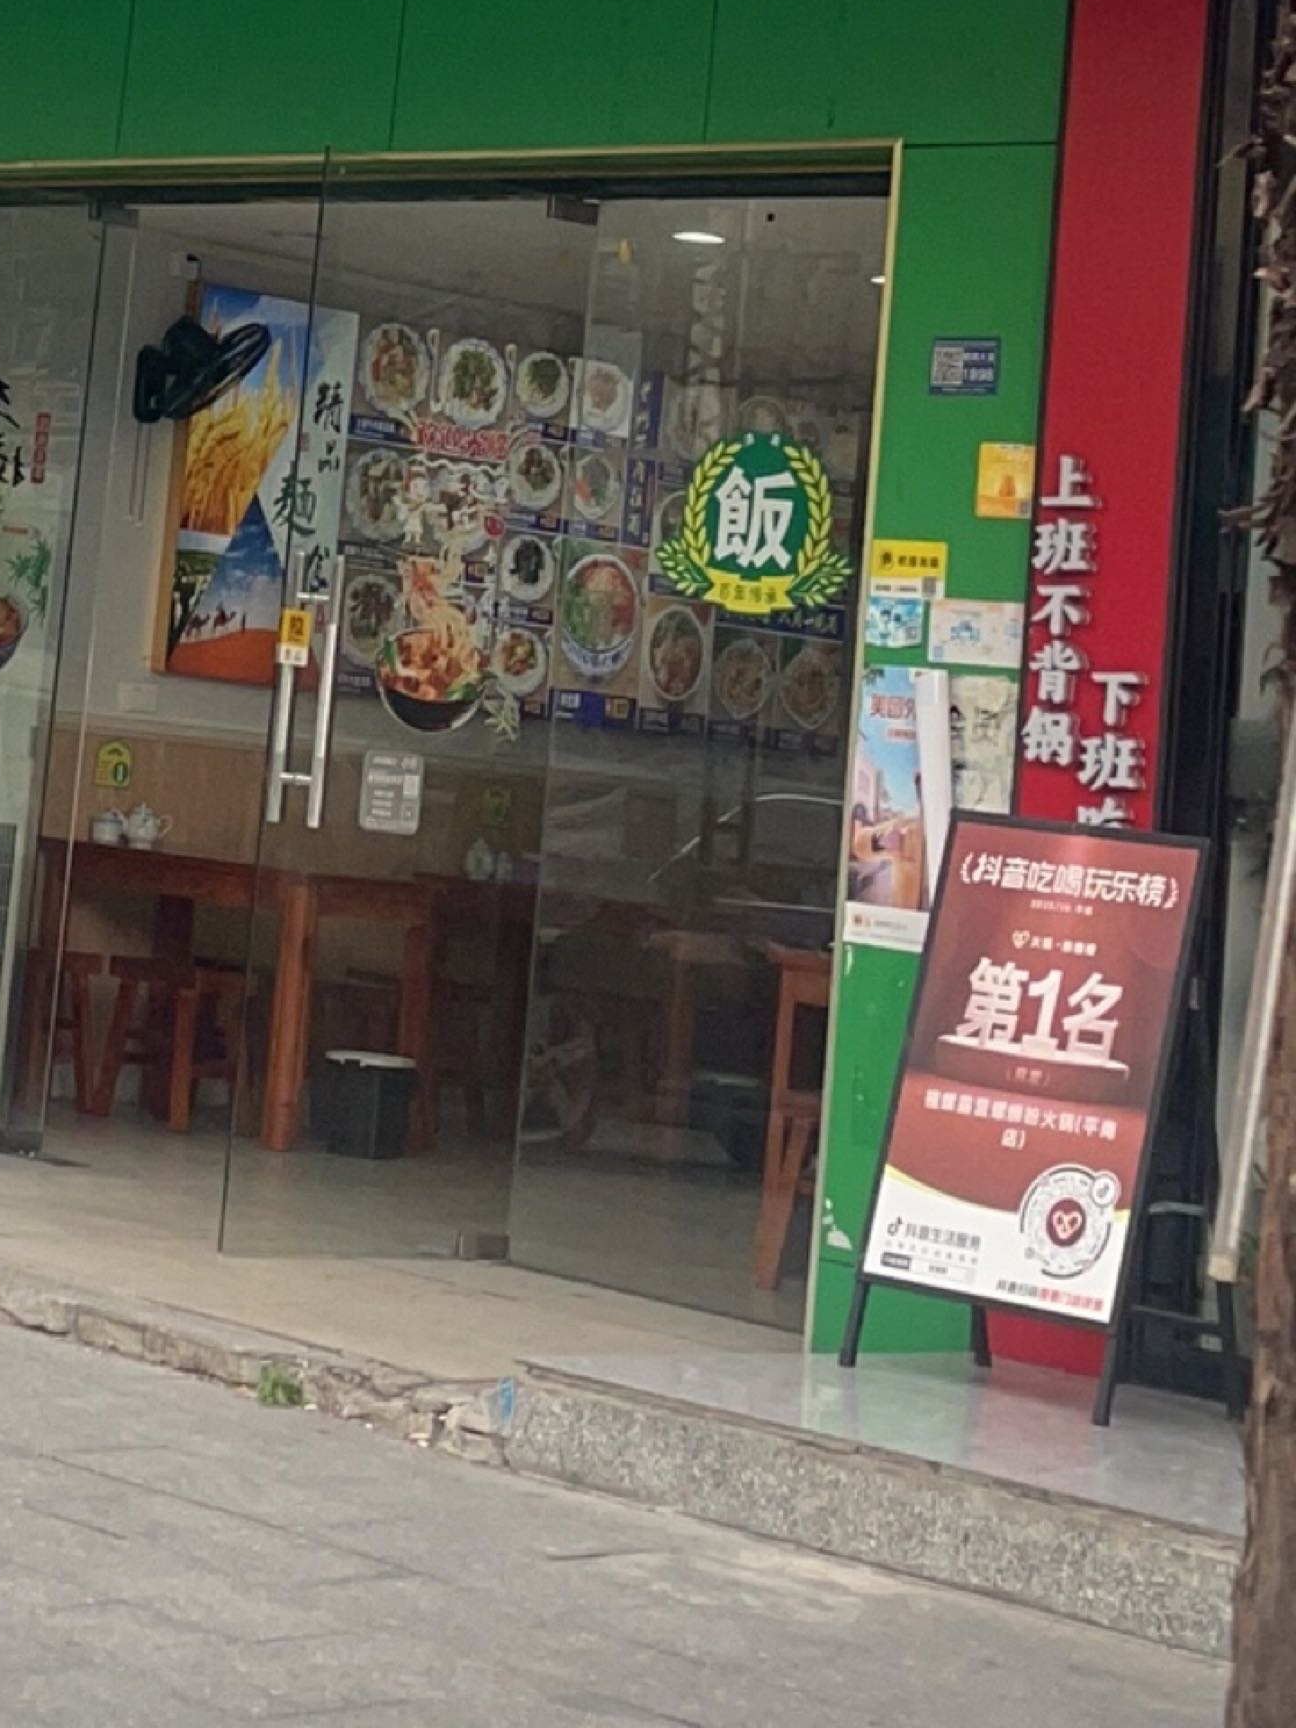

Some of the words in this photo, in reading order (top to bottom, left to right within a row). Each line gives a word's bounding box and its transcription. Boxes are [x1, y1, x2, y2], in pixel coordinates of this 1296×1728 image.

[714, 465, 797, 571] 飯
[1021, 454, 1095, 768] 上班不背锅
[956, 956, 1125, 1062] 第1名
